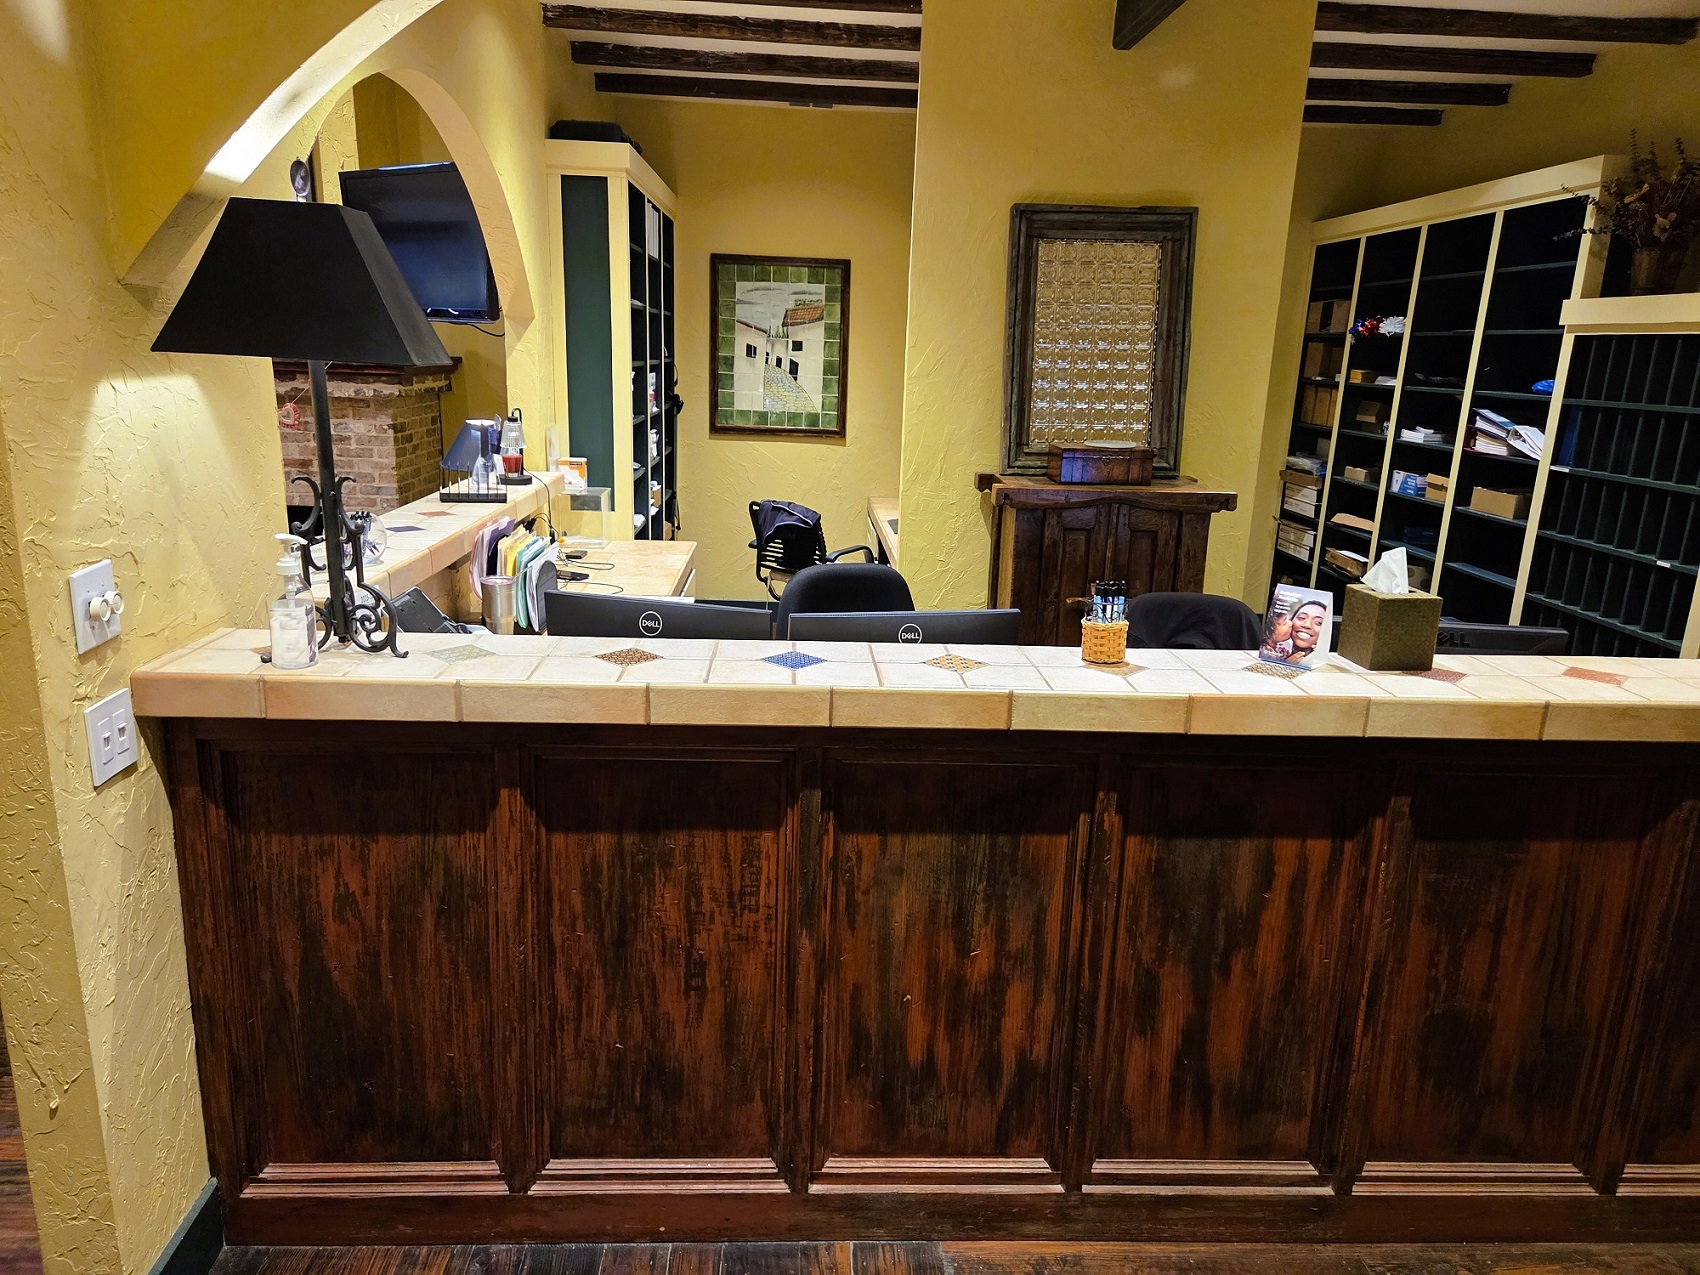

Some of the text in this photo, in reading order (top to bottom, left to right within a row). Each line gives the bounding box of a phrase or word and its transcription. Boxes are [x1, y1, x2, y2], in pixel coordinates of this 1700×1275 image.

[641, 619, 660, 628] DELL
[901, 632, 920, 640] DELL
[1436, 631, 1470, 648] ELL
